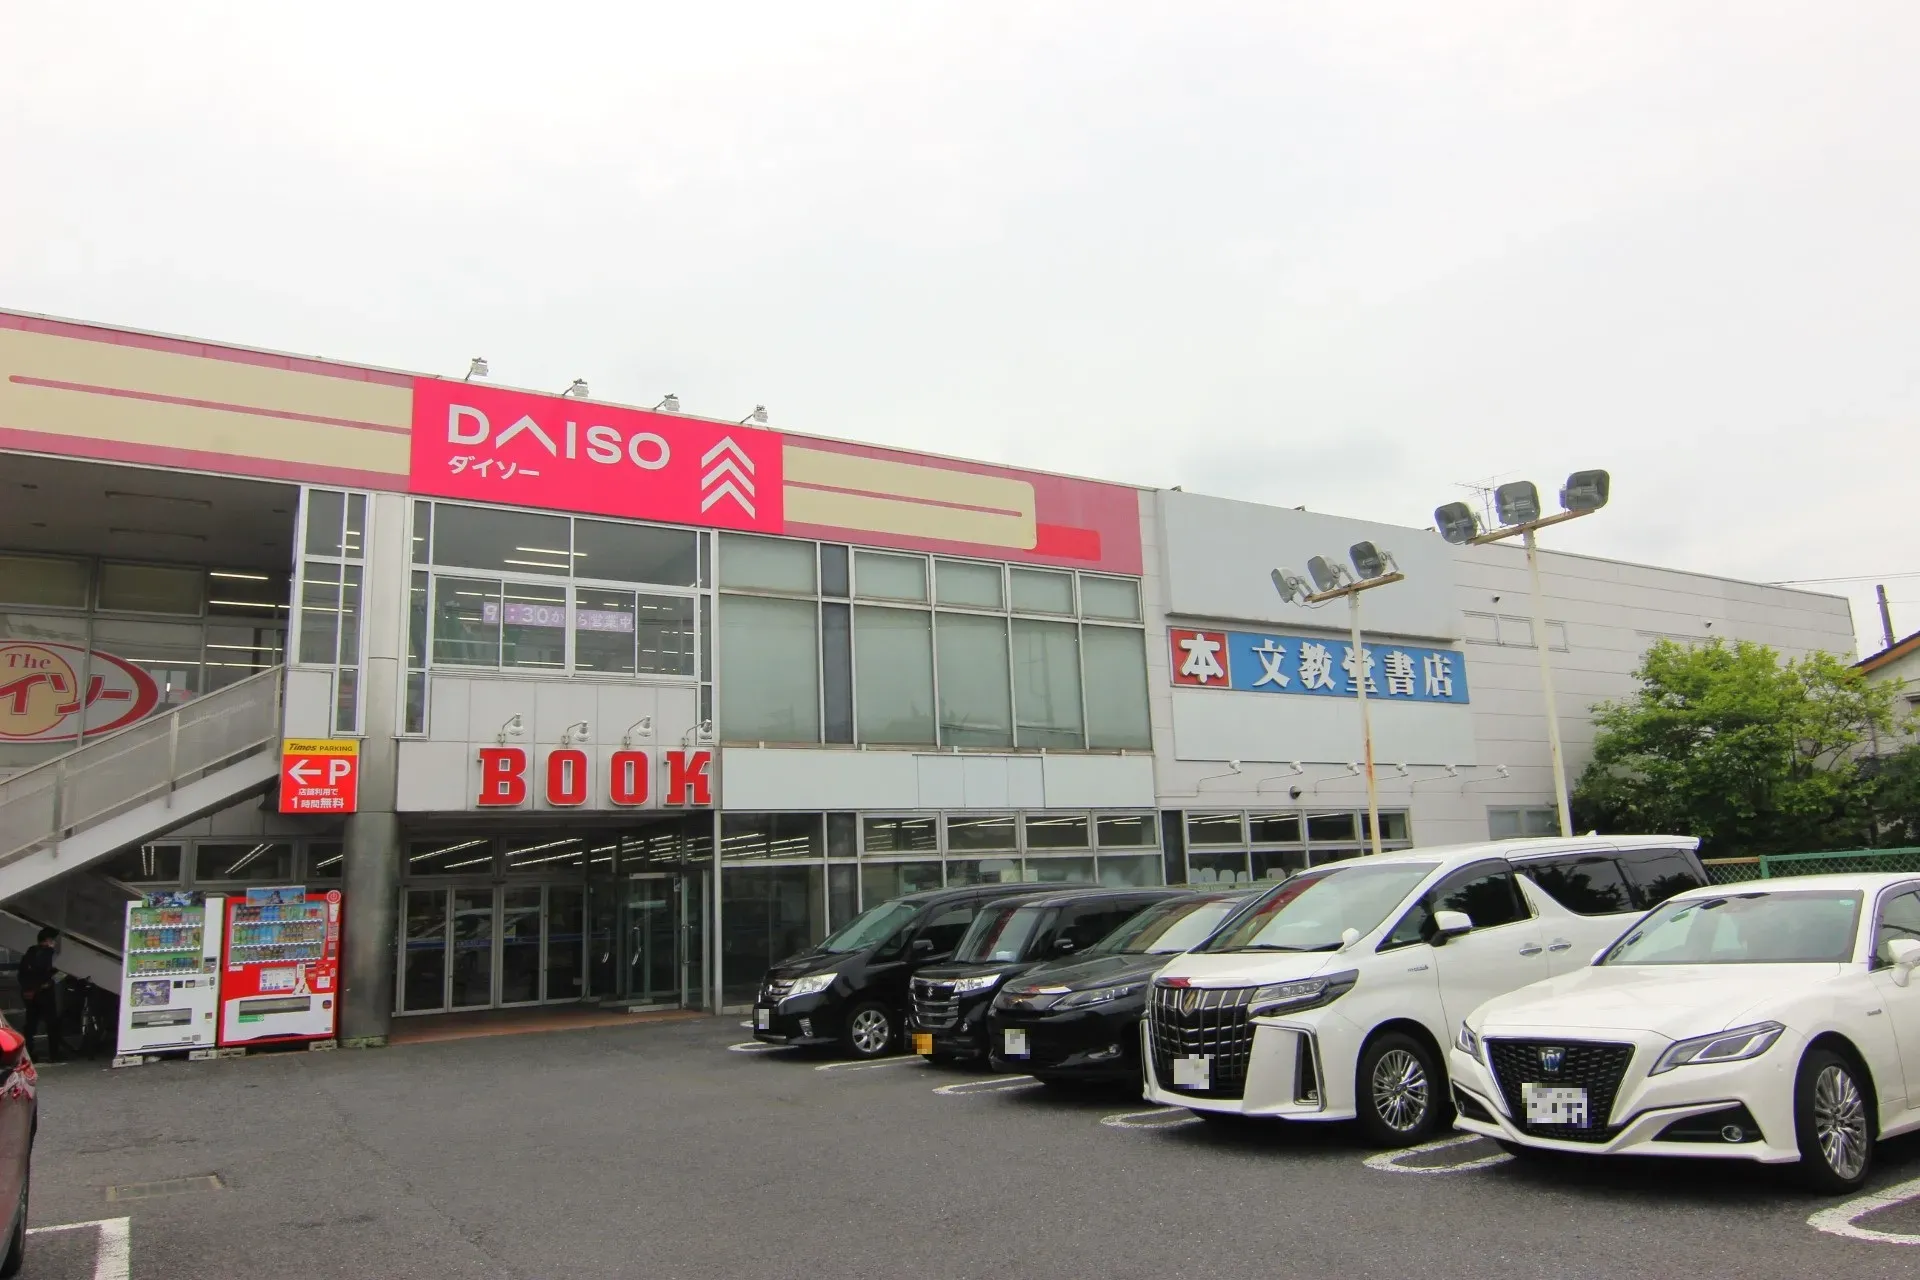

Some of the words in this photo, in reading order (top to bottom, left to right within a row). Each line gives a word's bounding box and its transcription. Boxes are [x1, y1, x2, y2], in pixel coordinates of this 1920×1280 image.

[447, 403, 671, 470] DAISO
[447, 455, 540, 480] ダイソー
[5, 653, 51, 669] The
[1180, 633, 1224, 683] 本
[1252, 639, 1453, 697] 文教堂書店
[289, 743, 317, 751] Times
[329, 759, 351, 785] P
[477, 747, 712, 806] BOOK
[291, 796, 344, 808] 1時間無料
[298, 788, 339, 796] 店舗利用で
